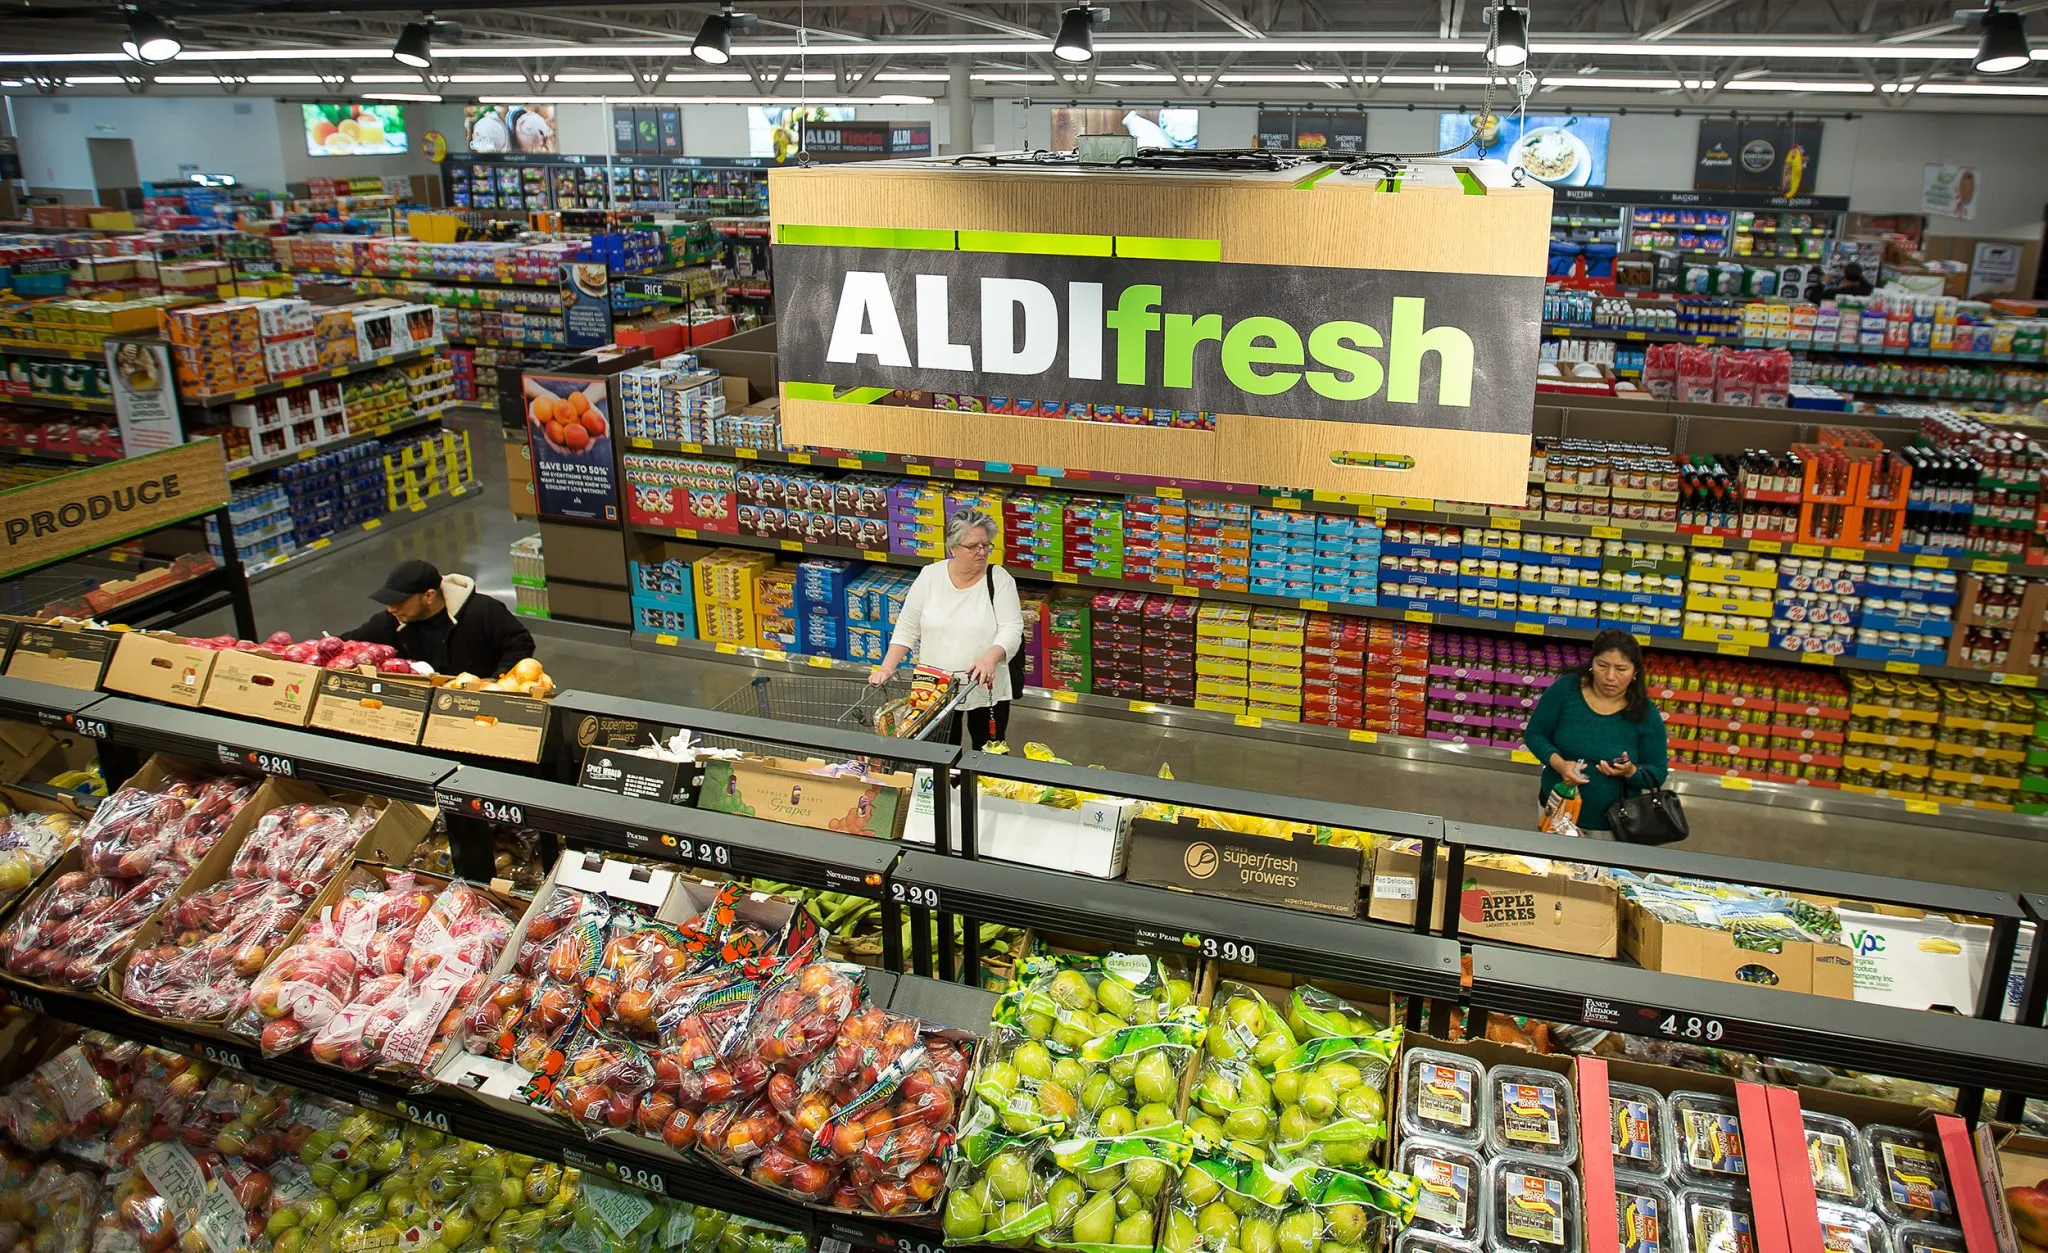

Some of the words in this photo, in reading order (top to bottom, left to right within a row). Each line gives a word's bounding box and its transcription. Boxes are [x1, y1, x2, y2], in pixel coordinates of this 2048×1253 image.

[1567, 190, 1593, 198] BUTTER
[1672, 194, 1699, 202] BACON
[644, 284, 662, 296] RICE
[539, 461, 561, 471] SAVE
[562, 463, 574, 472] UP
[575, 464, 587, 473] TO
[5, 474, 181, 545] PRODUCE
[600, 720, 638, 731] superfresh
[587, 763, 602, 773] SPICE
[603, 766, 622, 778] WORLD
[920, 777, 934, 792] vp
[769, 797, 812, 817] Grapes
[627, 831, 648, 842] PEACHES
[1225, 844, 1249, 853] DOMEX
[1223, 851, 1298, 872] superfresh
[826, 870, 860, 882] NECTARINES
[1376, 876, 1386, 884] Red
[1387, 877, 1413, 885] Delicious
[892, 883, 938, 906] 2.29
[1284, 897, 1349, 912] superfreshgrowers.com
[1482, 895, 1534, 909] APPLE
[1483, 908, 1536, 921] ACRES
[1137, 929, 1157, 938] ANJOU
[1159, 932, 1180, 942] PEARS
[1850, 930, 1886, 955] vpc
[1203, 938, 1255, 964] 3.99
[1109, 957, 1148, 969] d'Anjou
[1854, 965, 1877, 973] roduce
[1585, 998, 1610, 1009] FANCY
[1585, 1010, 1608, 1020] DATES
[1586, 1005, 1620, 1017] MEDJOOL
[418, 1001, 442, 1036] POMMES
[1659, 1014, 1723, 1041] 4.89
[384, 1029, 403, 1059] PINK
[398, 1027, 416, 1062] ADY
[563, 1147, 586, 1159] GRANNY
[158, 1165, 192, 1208] GALA
[206, 1193, 235, 1225] ALA
[597, 1195, 629, 1232] GRANNY
[611, 1193, 638, 1224] SMITH
